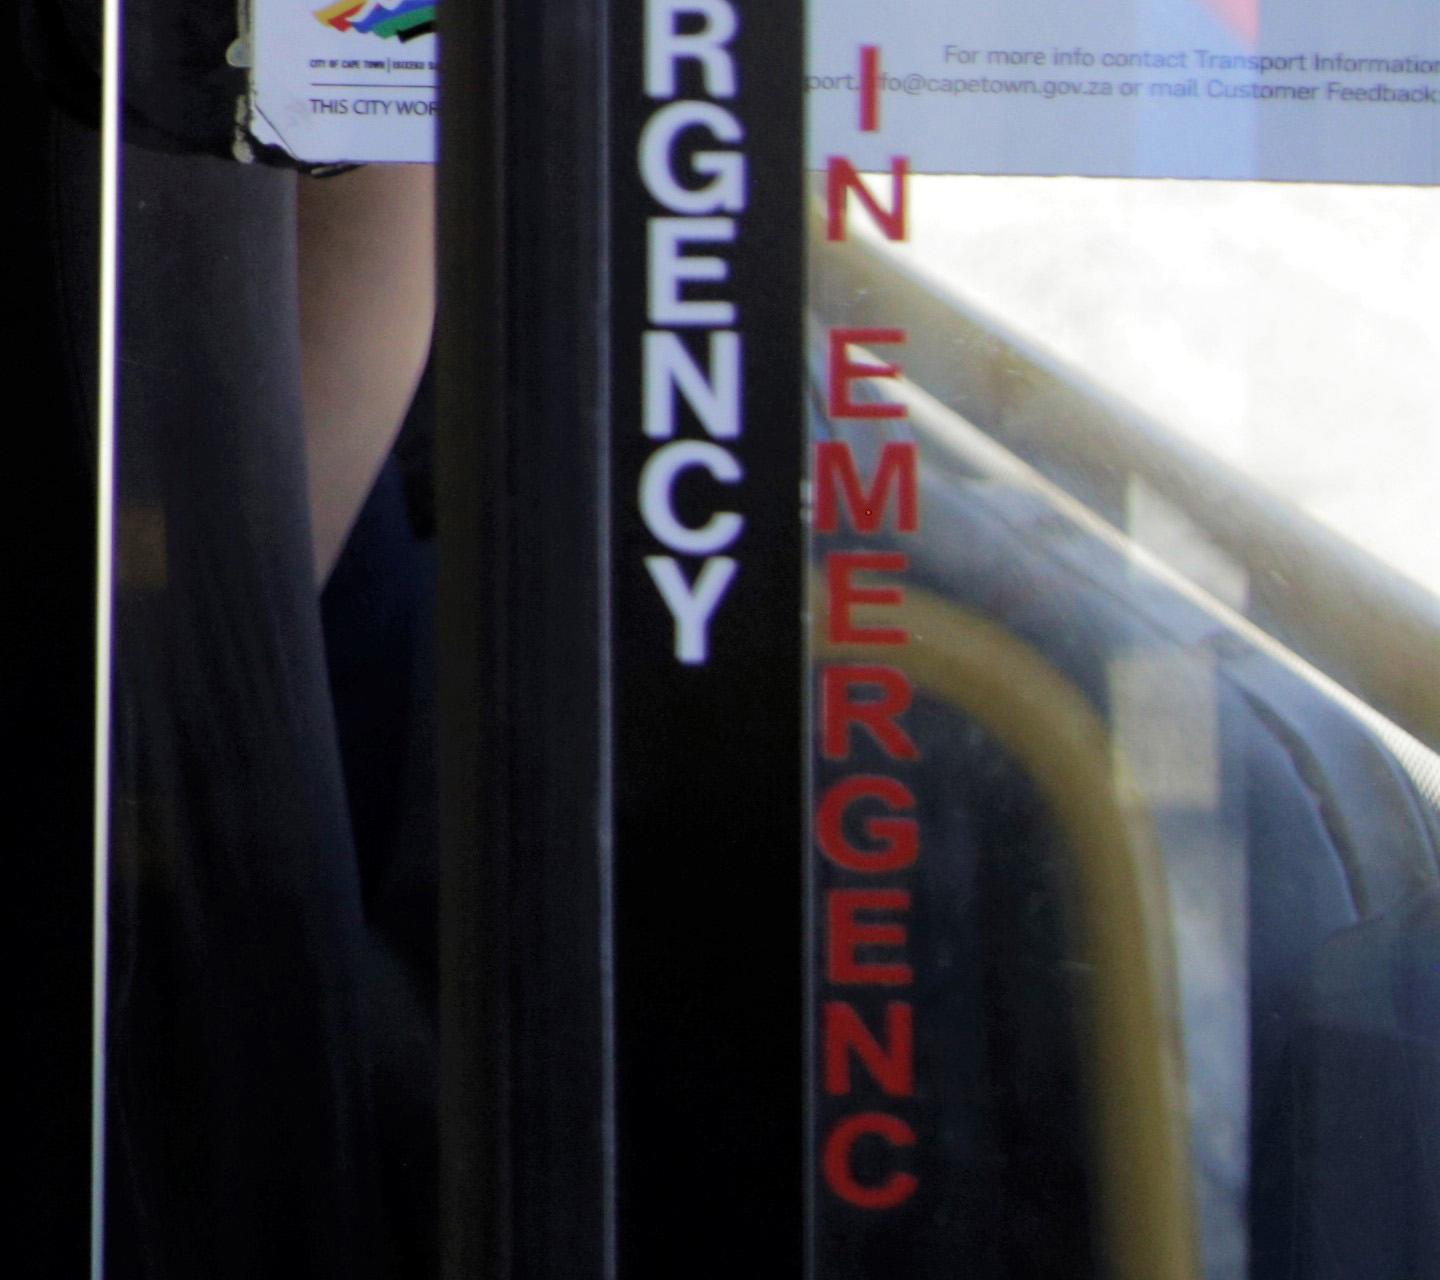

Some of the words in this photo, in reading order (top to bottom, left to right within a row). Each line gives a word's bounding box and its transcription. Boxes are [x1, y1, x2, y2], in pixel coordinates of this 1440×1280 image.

[944, 44, 980, 64] For
[987, 51, 1046, 66] more
[1052, 47, 1095, 67] info
[1099, 52, 1187, 68] contact
[1195, 49, 1308, 74] Transport
[1117, 82, 1141, 97] or
[1150, 79, 1199, 98] mail
[1209, 80, 1320, 101] Customer
[309, 99, 348, 114] THIS
[352, 99, 392, 115] CITY
[825, 45, 912, 241] IN
[812, 327, 920, 1209] EMERGENC
